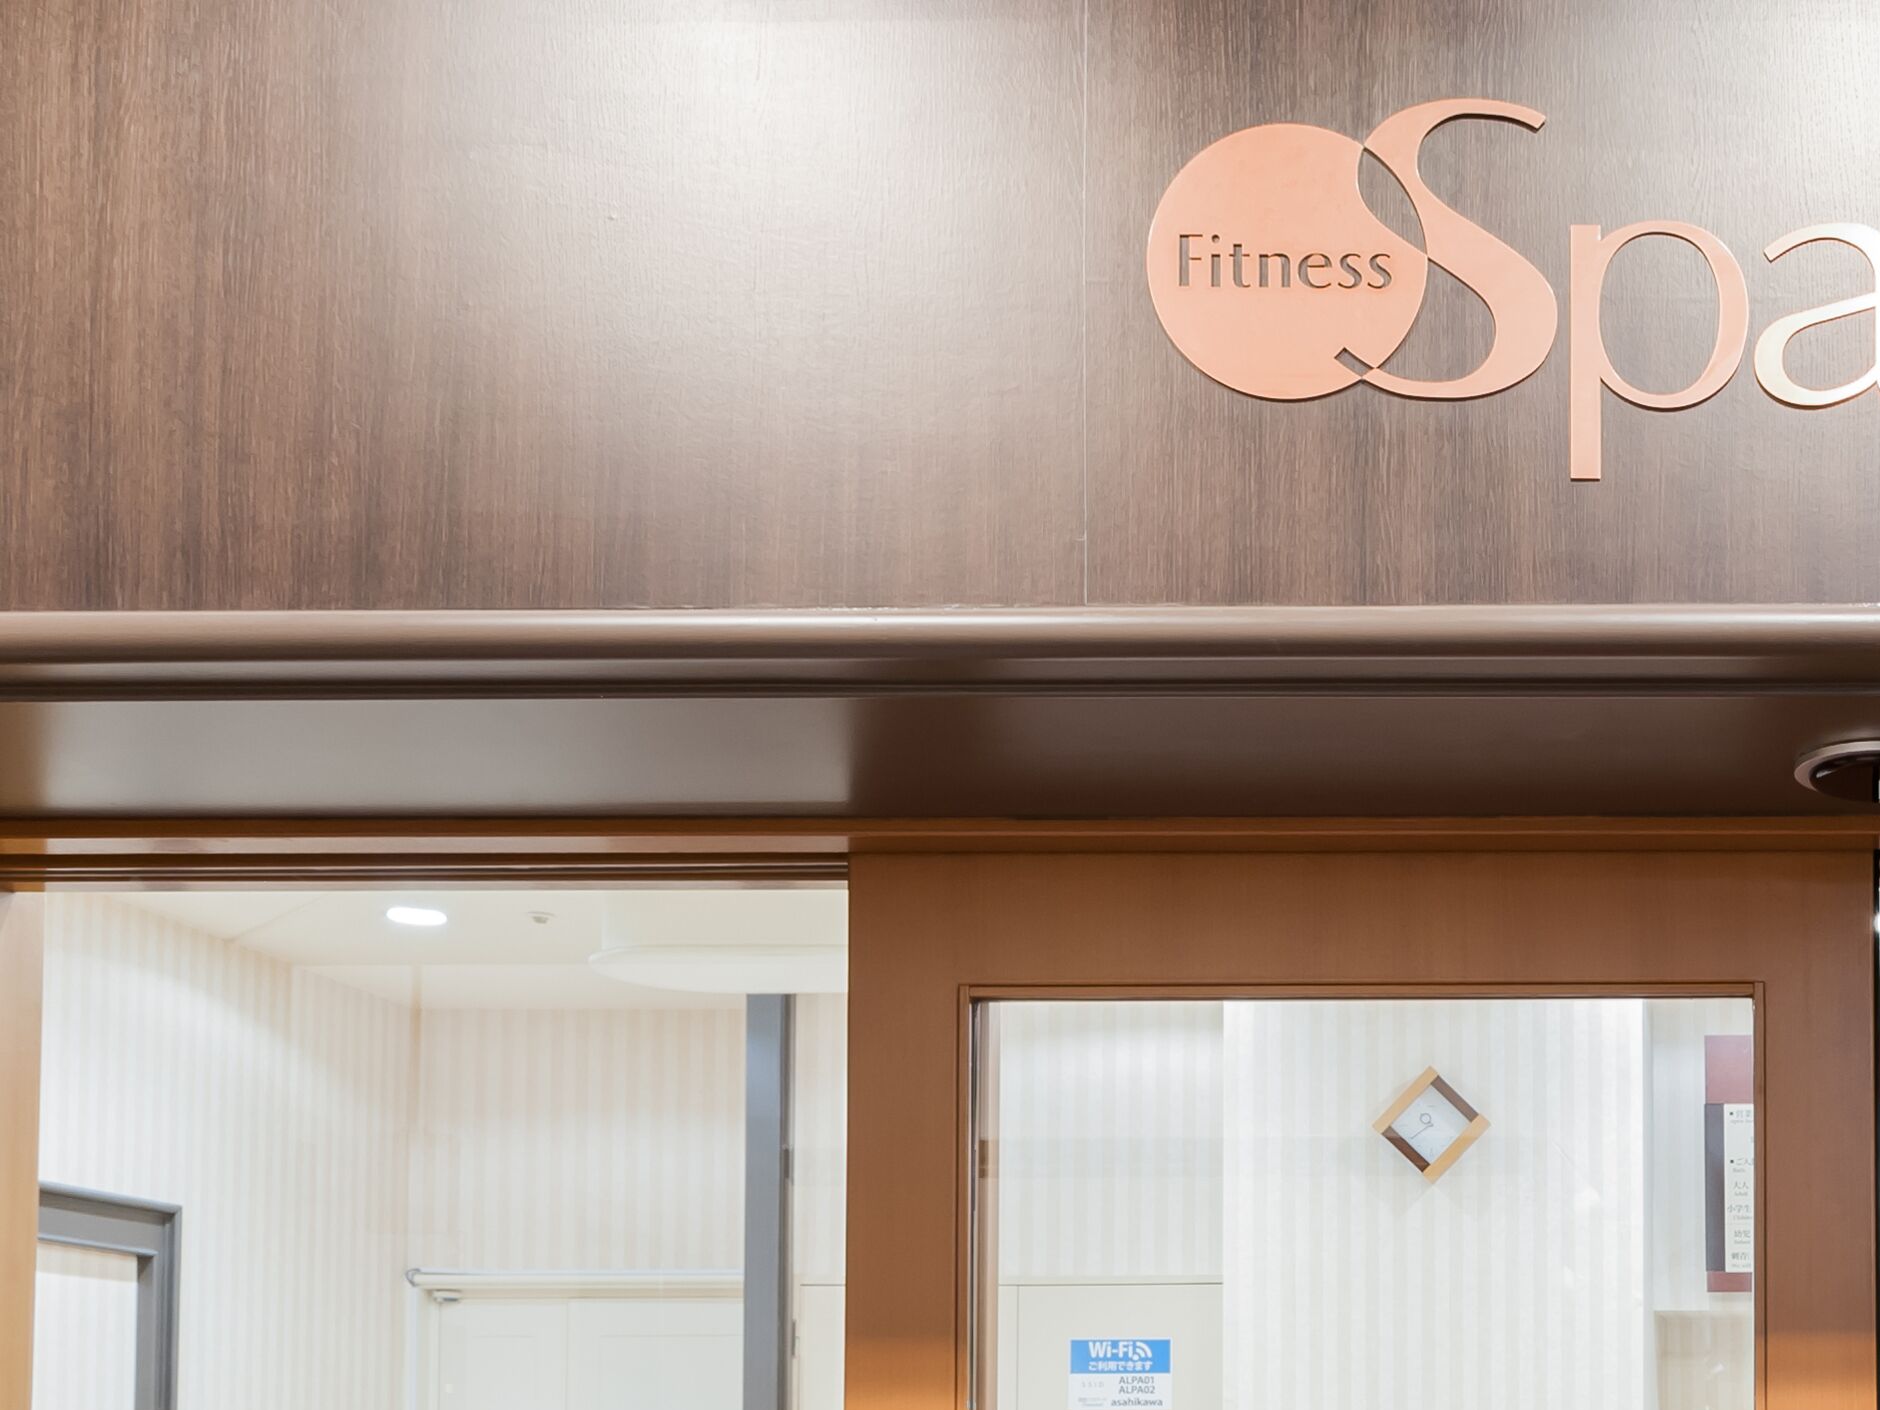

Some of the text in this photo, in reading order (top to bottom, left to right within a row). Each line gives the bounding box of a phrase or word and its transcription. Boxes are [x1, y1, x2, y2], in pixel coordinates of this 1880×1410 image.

[1177, 233, 1393, 290] Fitness
[1088, 1341, 1133, 1358] Wi-Fi
[1089, 1360, 1153, 1371] ご利用できます
[1119, 1376, 1155, 1385] ALPA01
[1119, 1385, 1156, 1394] ALPA02
[1111, 1397, 1163, 1407] asahikawa
